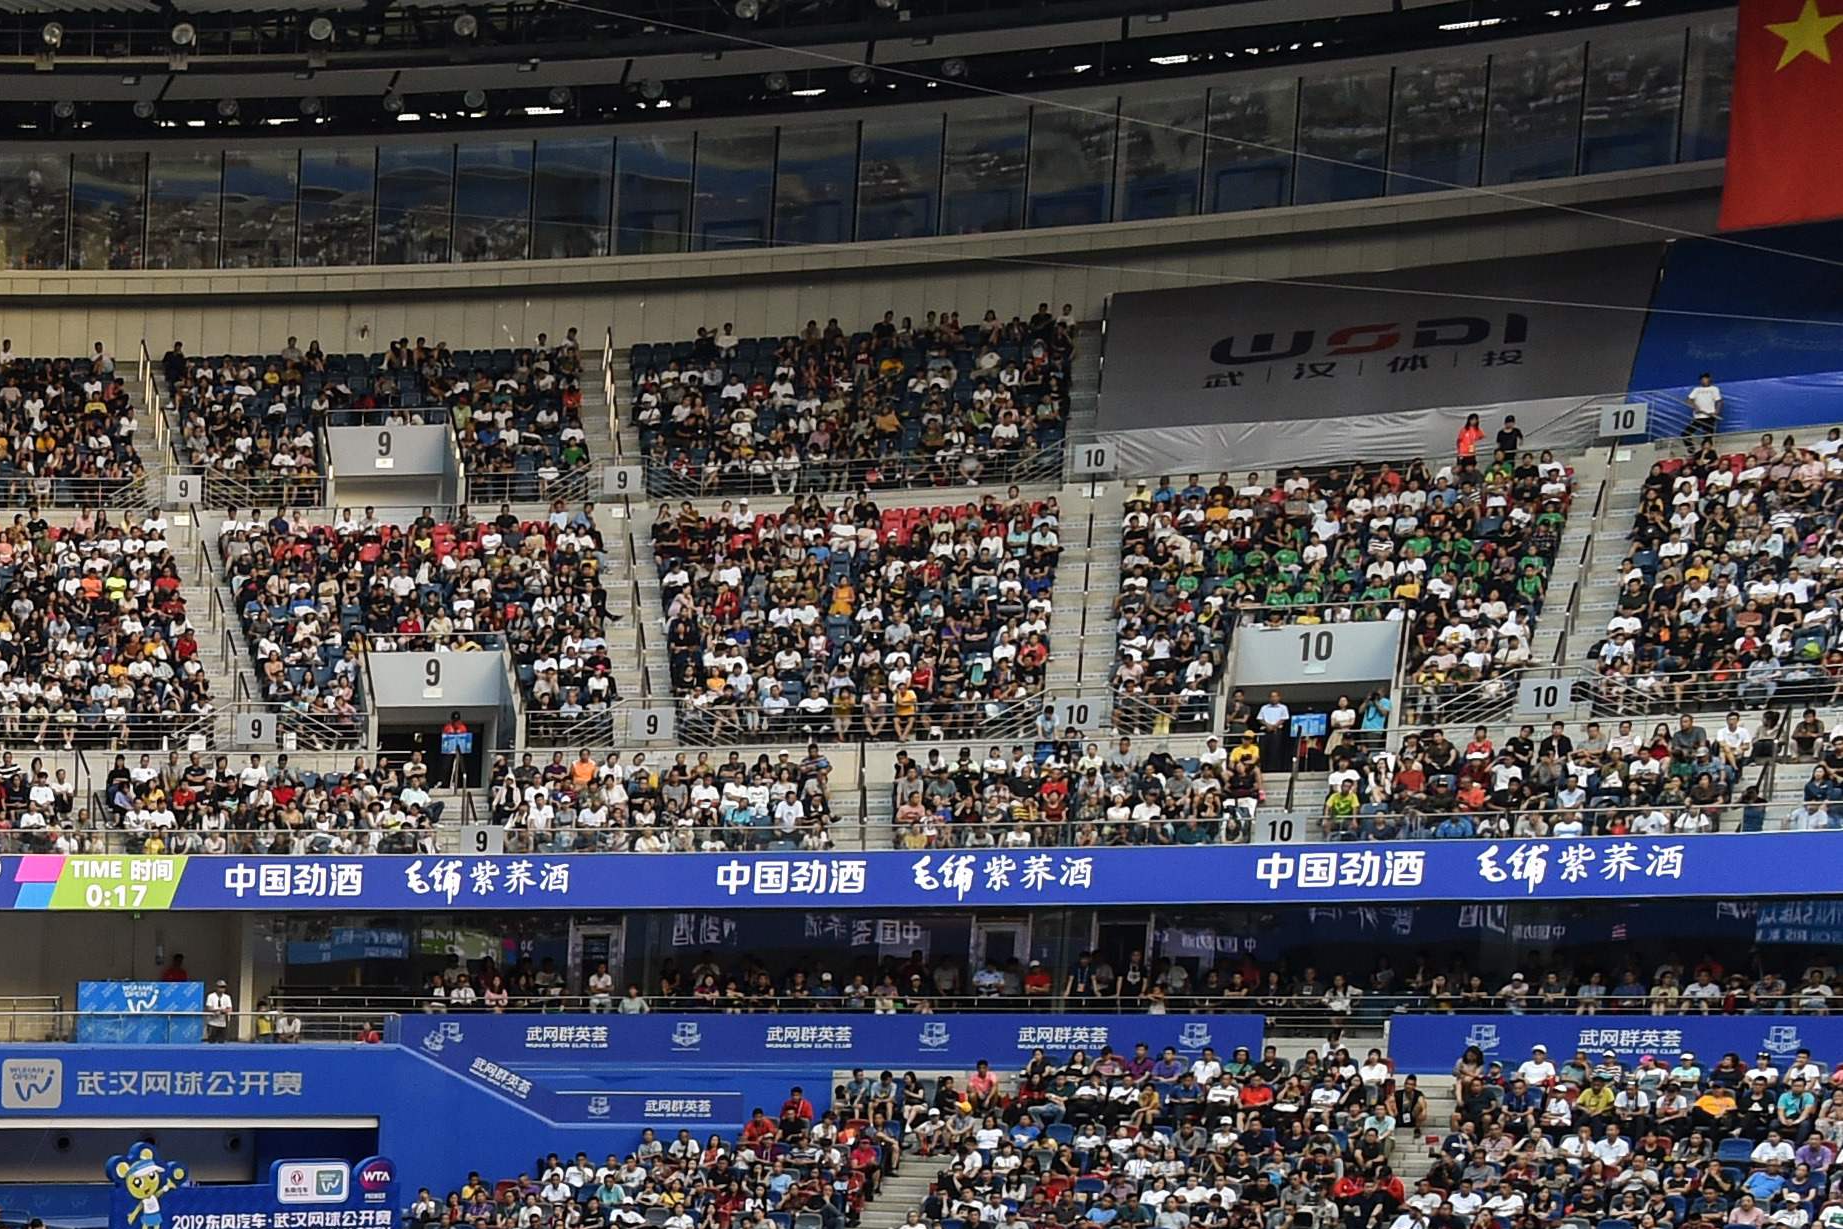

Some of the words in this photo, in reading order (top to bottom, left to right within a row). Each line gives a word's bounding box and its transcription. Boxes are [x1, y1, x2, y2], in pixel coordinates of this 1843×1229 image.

[1613, 409, 1636, 431] 10
[378, 431, 393, 457] 9
[1085, 448, 1106, 468] 10
[178, 479, 189, 499] 9
[617, 471, 629, 490] 9
[1299, 630, 1335, 663] 10
[426, 658, 442, 688] 9
[1533, 685, 1559, 709] 10
[646, 714, 659, 736] 9
[1066, 703, 1089, 725] 10
[251, 718, 263, 740] 9
[476, 830, 489, 854] 9
[1268, 819, 1294, 843] 10
[71, 860, 122, 879] TIME
[130, 859, 174, 882] 时间
[225, 862, 364, 898] 中国劲酒
[716, 859, 867, 895] 中国劲酒
[1256, 850, 1426, 890] 中国劲酒
[86, 884, 147, 908] 0:17
[525, 1026, 609, 1043] 武网群英荟
[766, 1026, 852, 1042] 武网群英荟
[1018, 1026, 1109, 1043] 武网群英荟
[1578, 1030, 1682, 1047] 武网群英荟
[77, 1071, 302, 1096] 武汉网球公开赛
[363, 1170, 391, 1182] WTA
